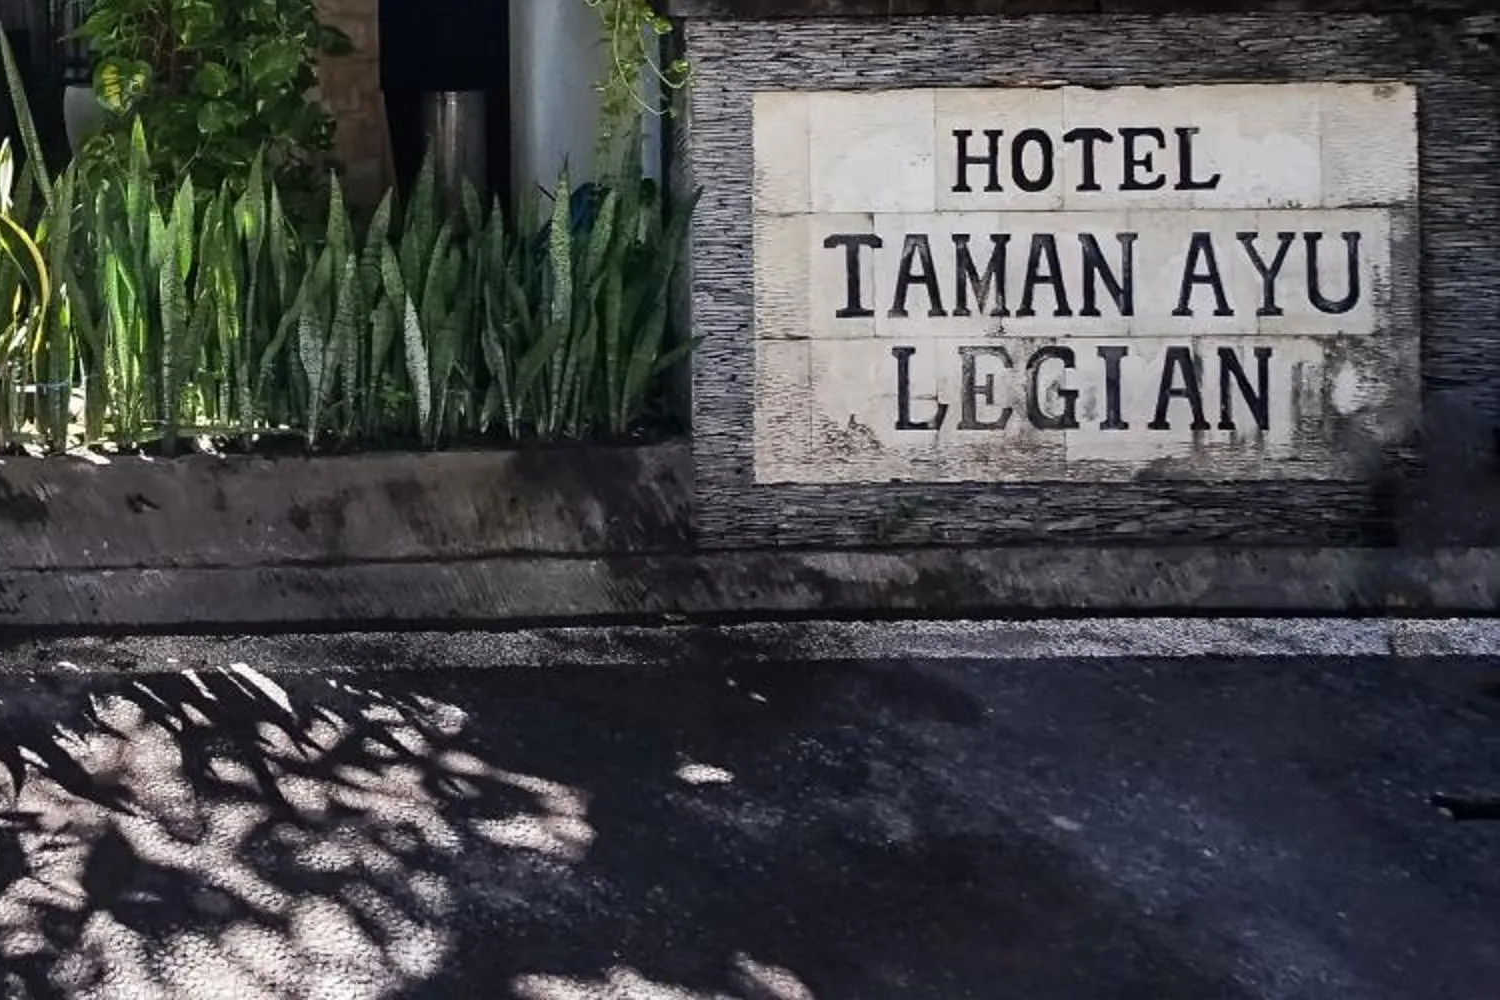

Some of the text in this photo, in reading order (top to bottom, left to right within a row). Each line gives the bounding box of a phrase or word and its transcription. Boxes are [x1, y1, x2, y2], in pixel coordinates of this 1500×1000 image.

[952, 126, 1221, 193] HOTEL
[823, 231, 1361, 318] TAMAN AYU
[891, 345, 1272, 430] LEGIAN
